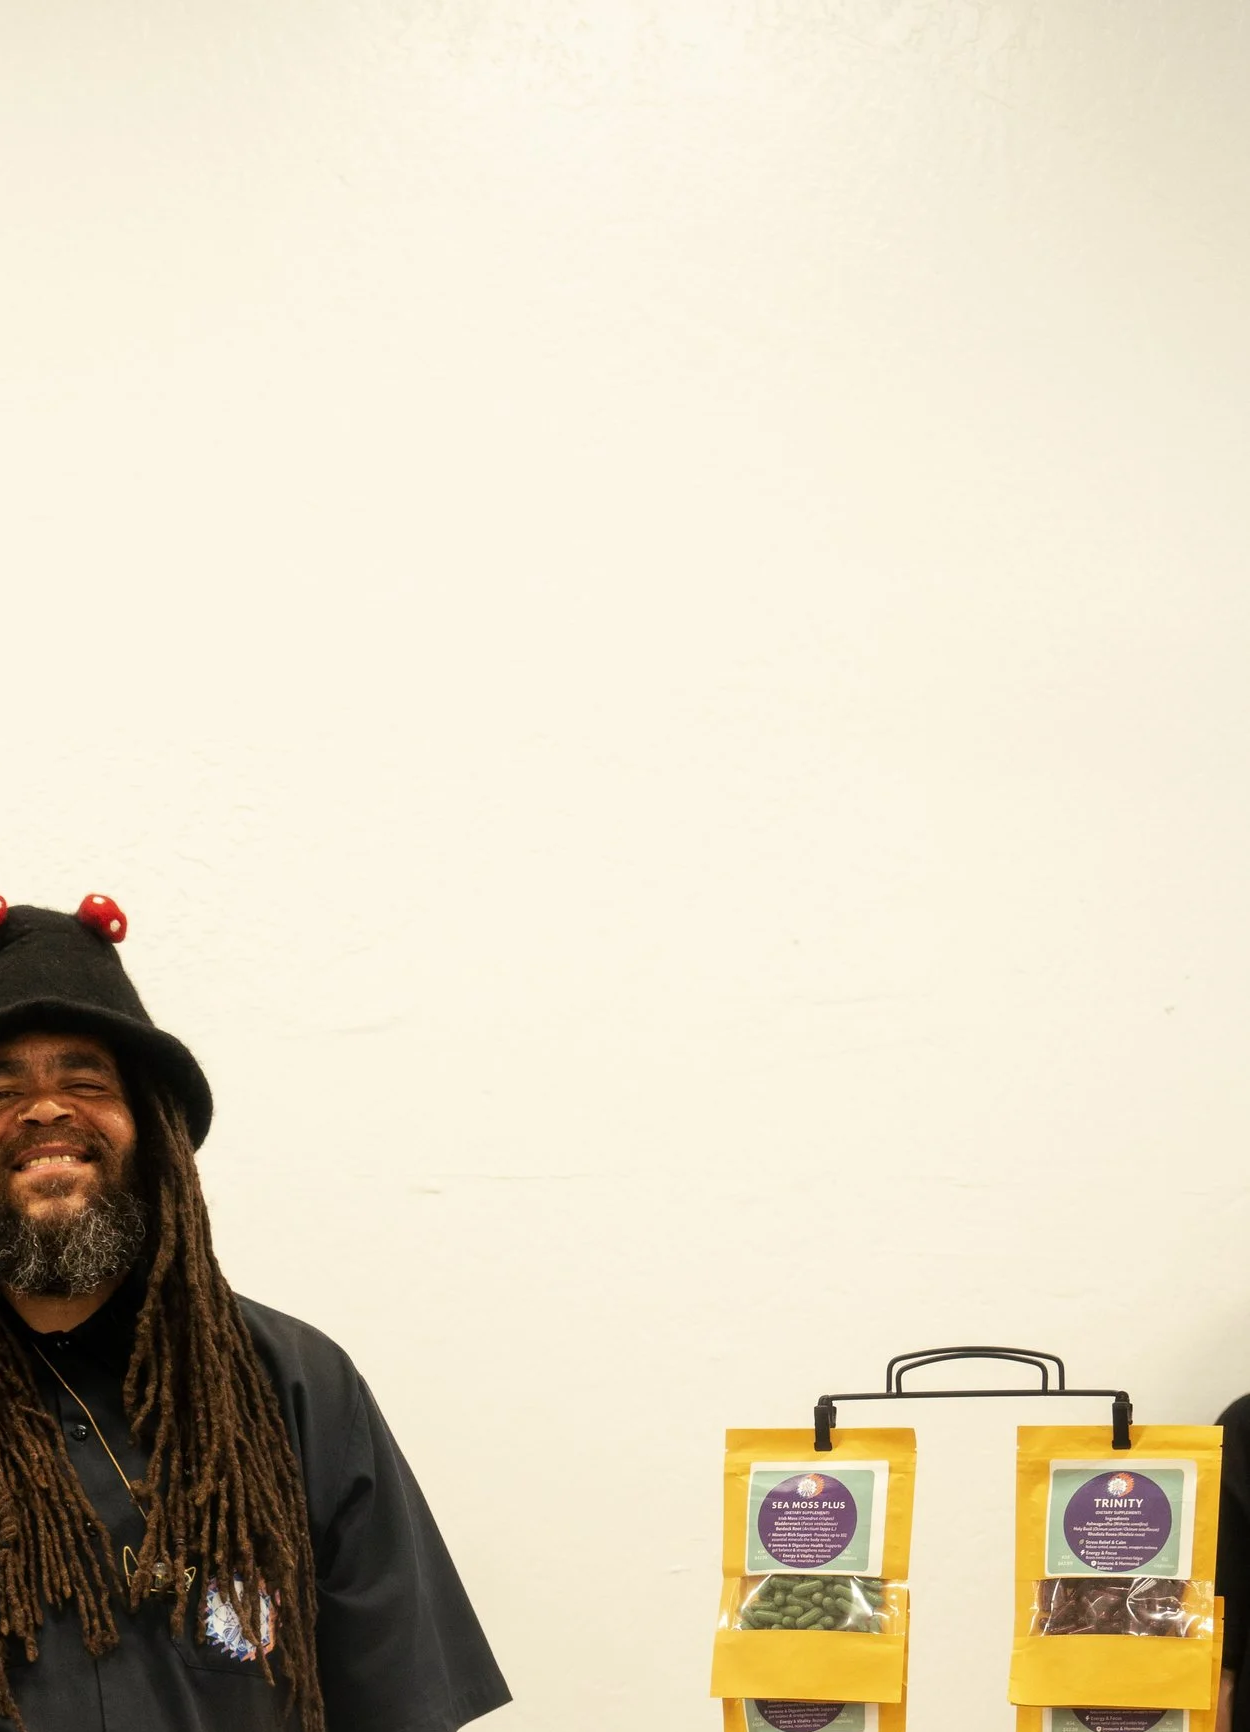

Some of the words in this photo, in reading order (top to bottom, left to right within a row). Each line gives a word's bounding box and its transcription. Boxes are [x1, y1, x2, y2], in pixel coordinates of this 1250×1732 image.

[772, 1501, 790, 1509] SEA
[791, 1501, 819, 1509] MOSS
[822, 1501, 846, 1509] PLUS
[1094, 1498, 1144, 1508] TRINITY
